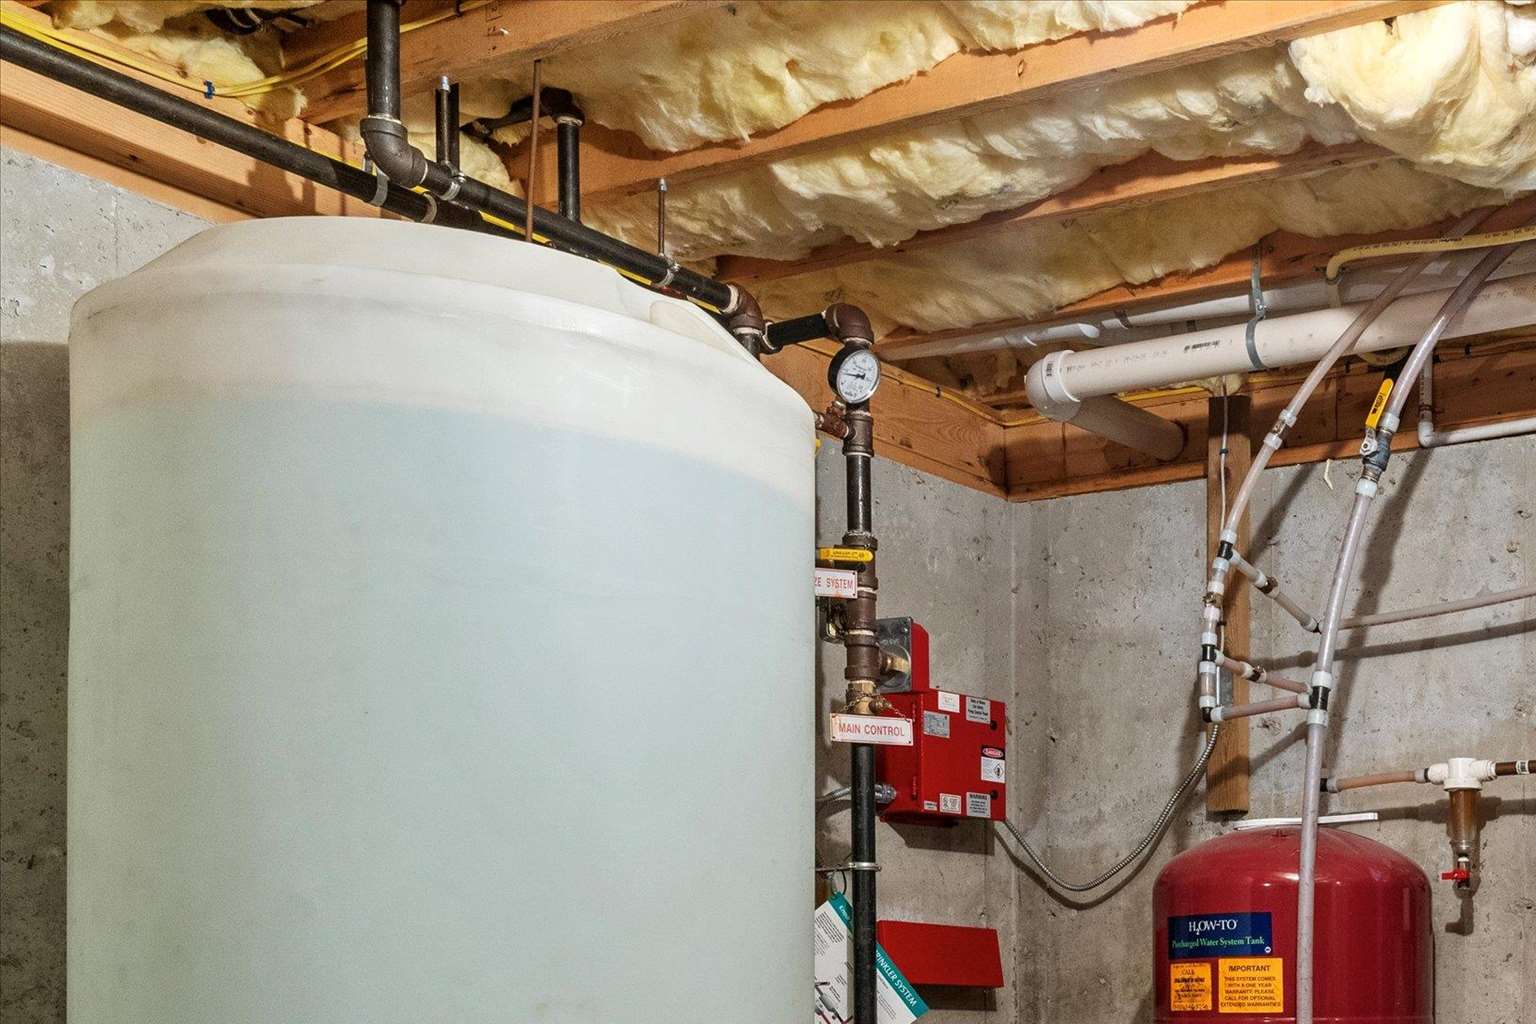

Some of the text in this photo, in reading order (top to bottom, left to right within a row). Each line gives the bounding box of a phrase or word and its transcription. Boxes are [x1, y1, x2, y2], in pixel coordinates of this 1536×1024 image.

[826, 575, 854, 589] SYSTEM
[838, 722, 905, 737] MAIN CONTROL
[1200, 938, 1219, 947] Water
[1219, 937, 1245, 949] System
[1245, 936, 1265, 945] Tank
[1228, 964, 1271, 973] IMPORTANT
[895, 979, 918, 1008] SYSTEM
